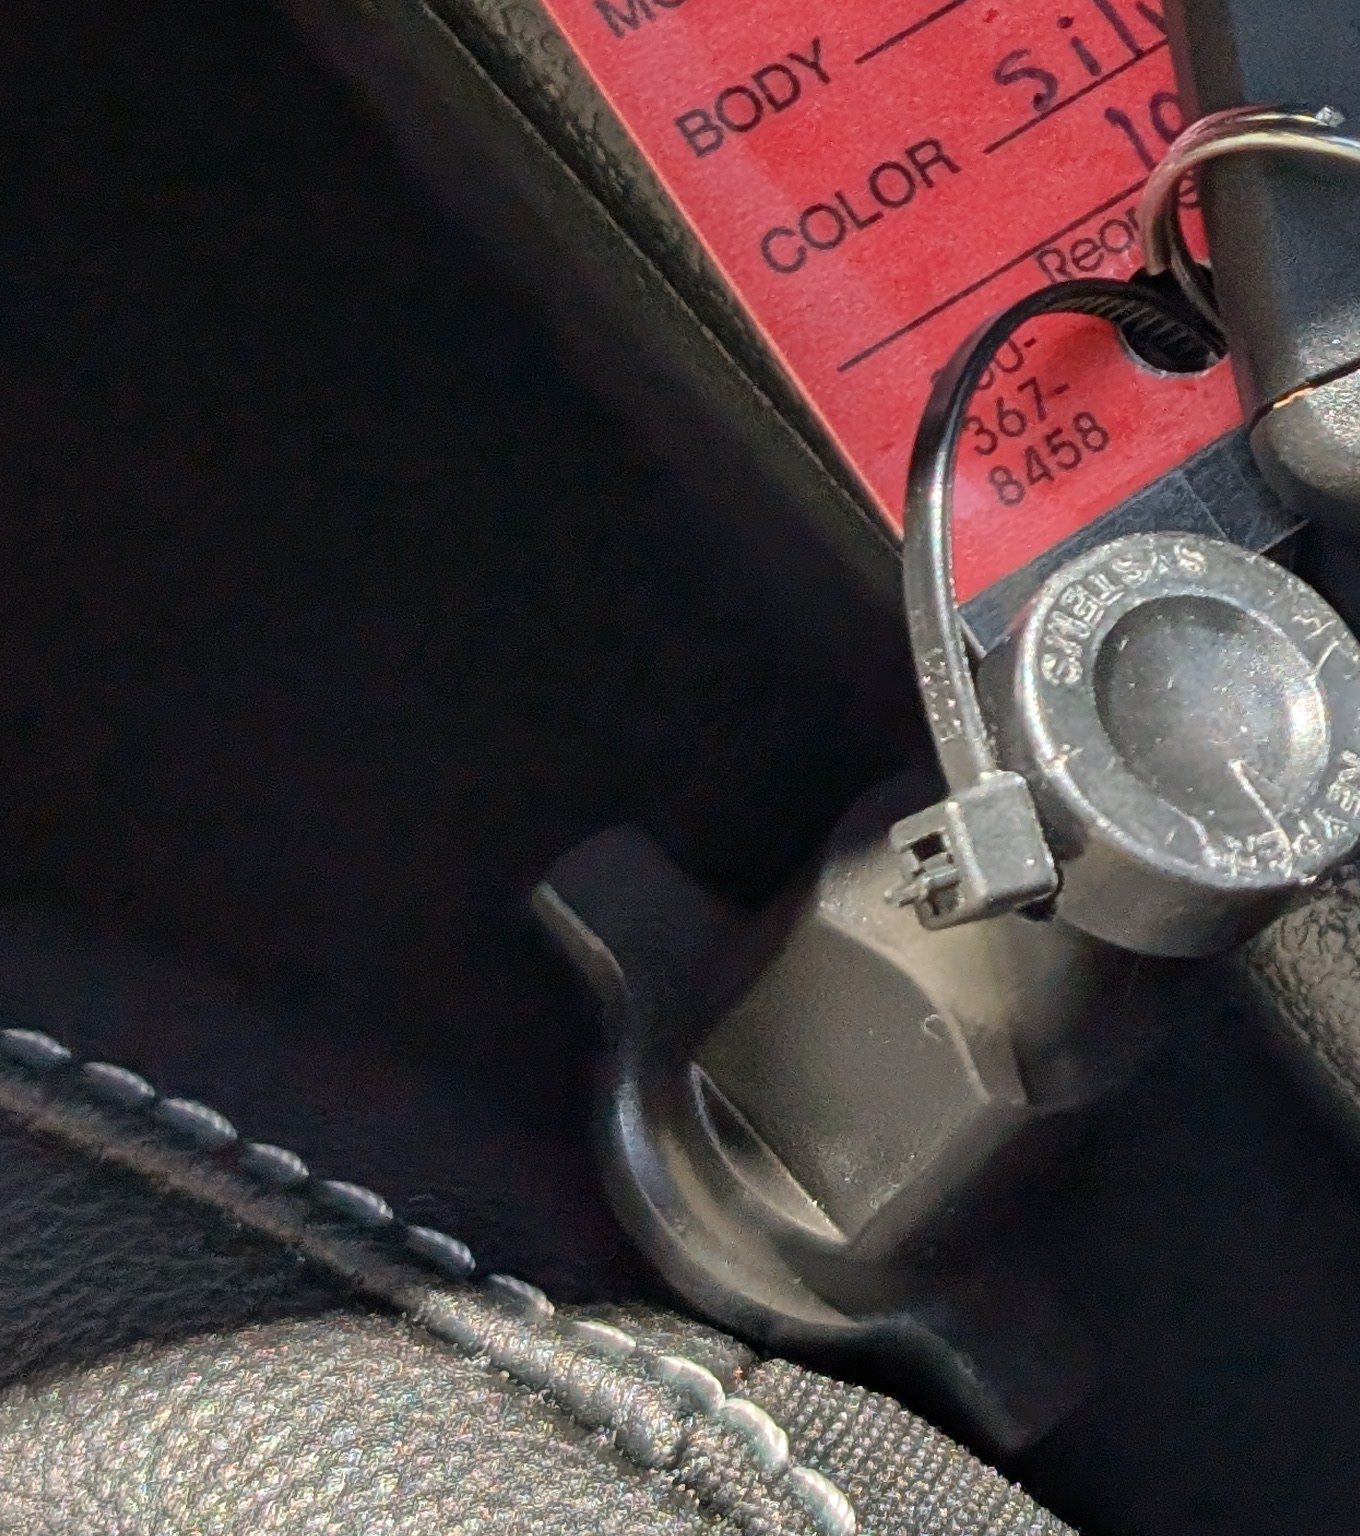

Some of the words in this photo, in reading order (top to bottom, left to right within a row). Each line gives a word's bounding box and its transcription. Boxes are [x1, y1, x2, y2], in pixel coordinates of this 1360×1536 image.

[675, 38, 833, 160] BODY
[759, 138, 961, 275] COLOR
[962, 381, 1069, 458] 367-
[989, 415, 1111, 507] 8458
